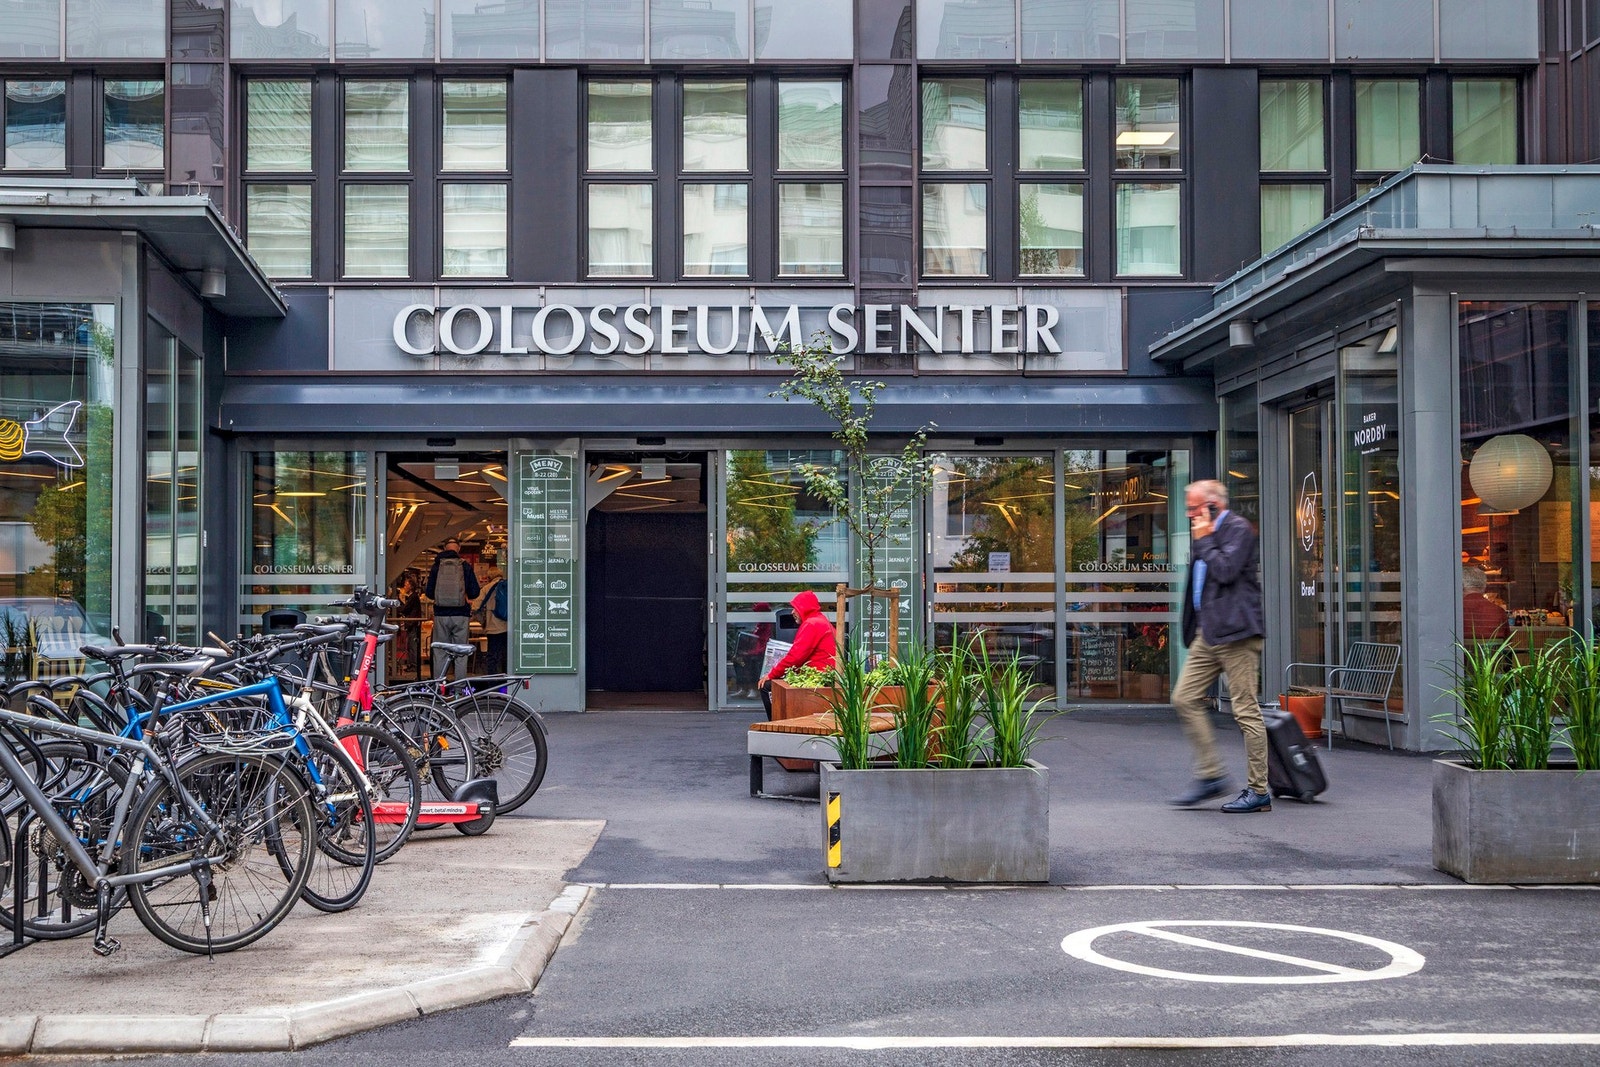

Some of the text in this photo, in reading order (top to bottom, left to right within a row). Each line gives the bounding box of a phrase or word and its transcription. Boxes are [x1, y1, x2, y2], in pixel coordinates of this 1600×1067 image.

[392, 303, 1063, 355] COLOSSEUM SENTER
[1363, 412, 1377, 423] BAKER
[1354, 423, 1387, 447] NORDBY
[533, 460, 560, 469] MENY
[253, 564, 354, 574] COLOSSEUM SENTER
[738, 562, 841, 572] COLOSSEUM SENTER
[1079, 562, 1178, 572] COLOSSEUM SENTER
[1300, 579, 1316, 597] Brød
[362, 653, 374, 671] voi.
